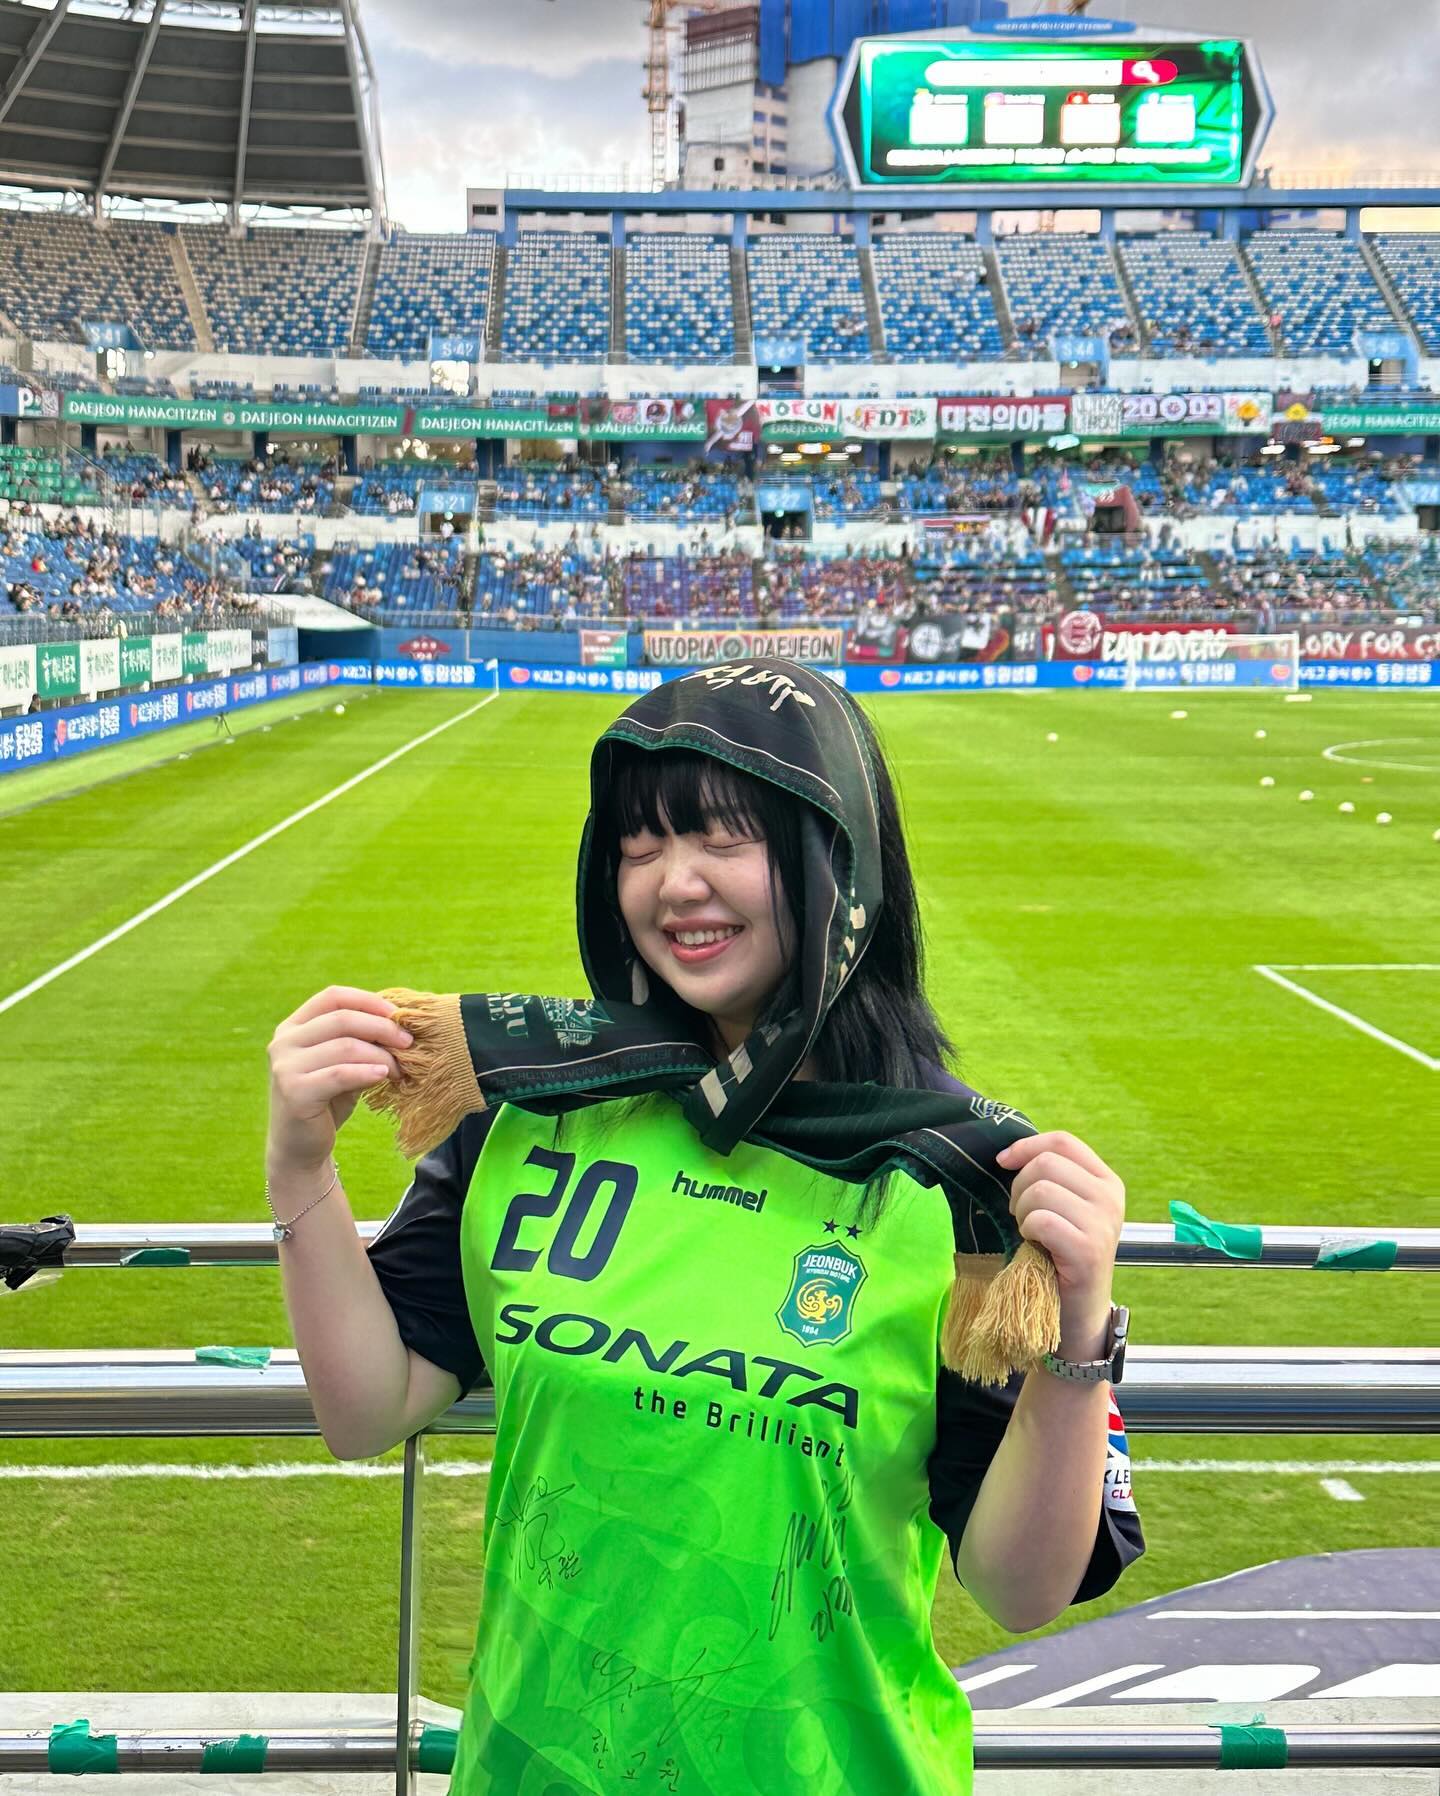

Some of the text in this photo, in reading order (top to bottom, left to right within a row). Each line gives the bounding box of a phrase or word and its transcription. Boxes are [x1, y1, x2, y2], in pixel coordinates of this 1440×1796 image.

[69, 401, 217, 421] DAEJEON HANACITIZEN
[240, 411, 398, 428] DAEJEON HANACITIZEN
[421, 416, 482, 430] DAEJEON
[652, 635, 717, 659] UTOPIA
[752, 635, 835, 659] DAEJEON
[1360, 630, 1409, 659] FOR
[671, 1170, 768, 1213] hummel
[490, 1145, 639, 1282] 20
[802, 1254, 858, 1279] JEONBUK
[495, 1303, 859, 1429] SONATA
[633, 1386, 845, 1467] the Brilliant
